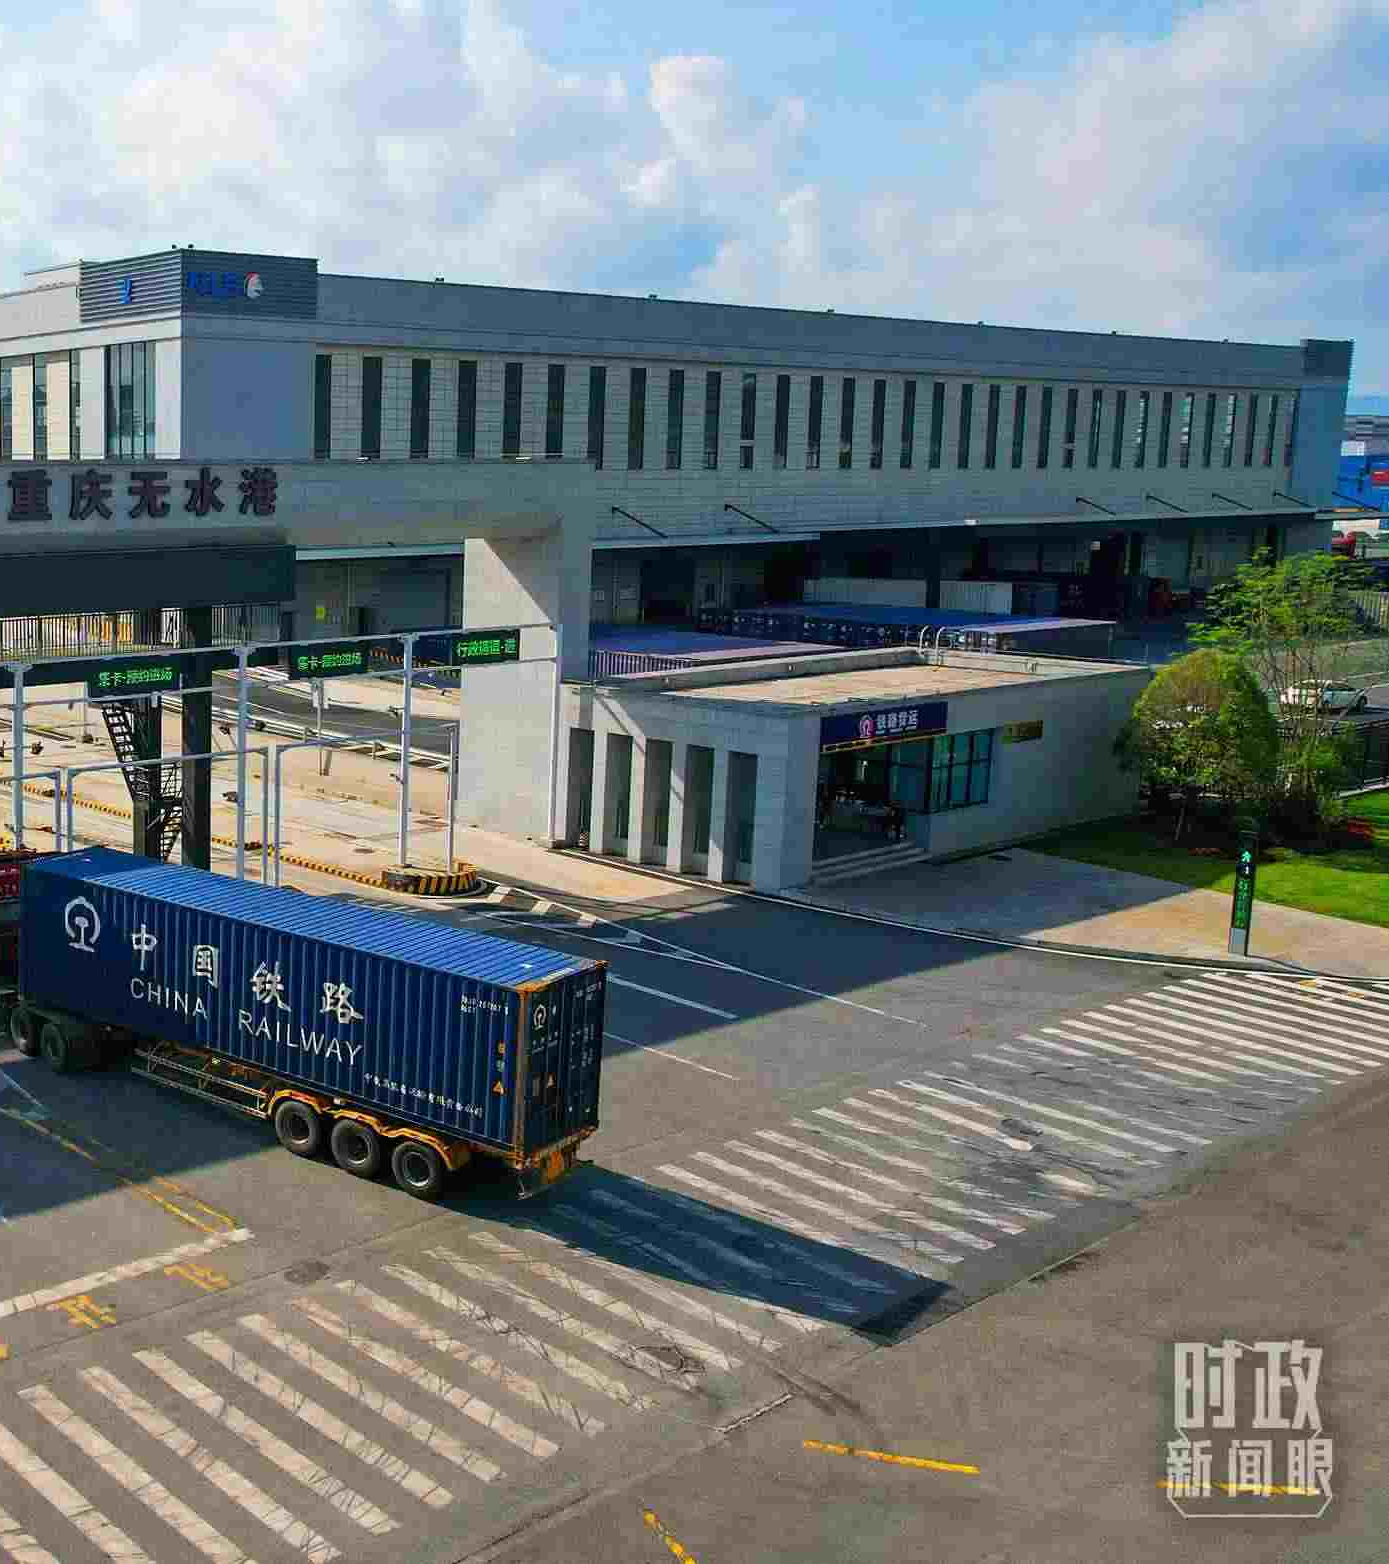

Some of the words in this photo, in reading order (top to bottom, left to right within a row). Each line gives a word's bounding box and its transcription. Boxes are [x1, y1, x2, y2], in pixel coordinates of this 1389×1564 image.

[131, 923, 365, 1024] 中国铁路
[130, 977, 209, 1020] CHINA
[238, 1009, 363, 1065] RAILWAY
